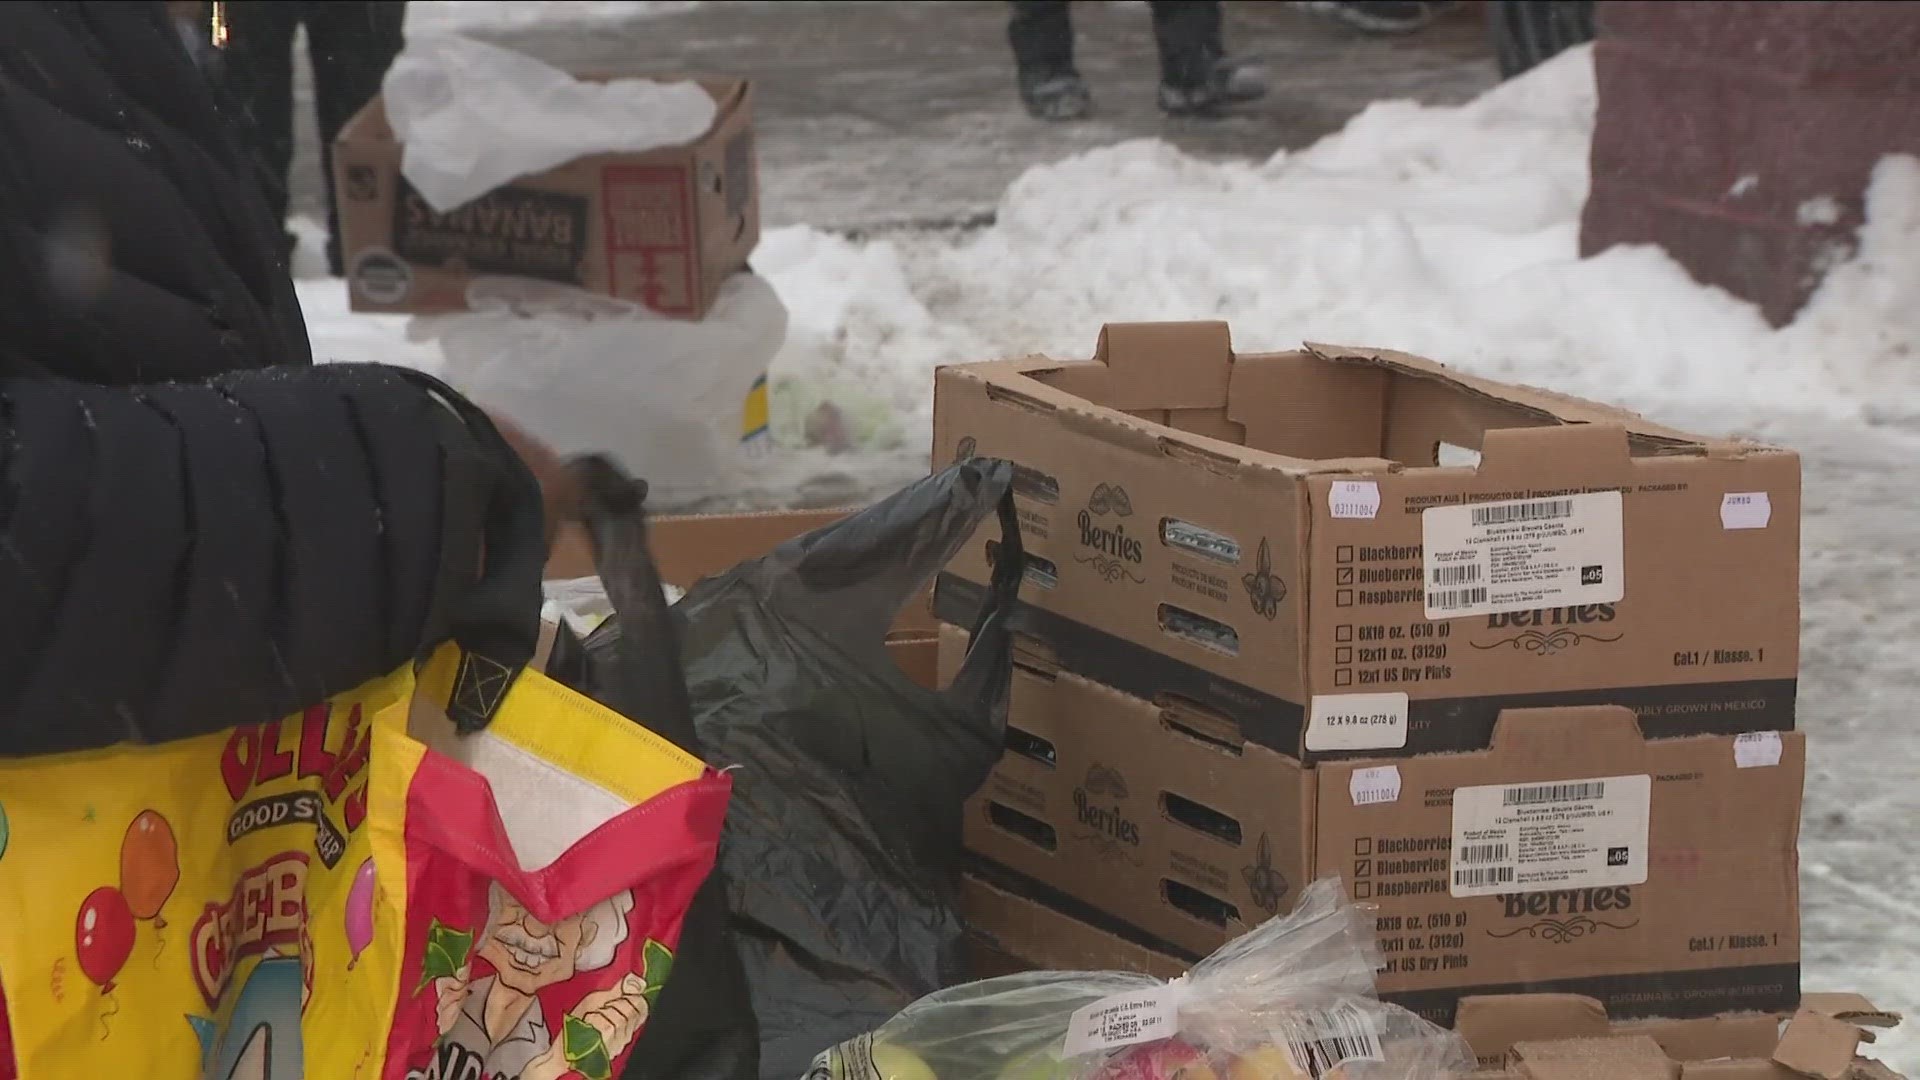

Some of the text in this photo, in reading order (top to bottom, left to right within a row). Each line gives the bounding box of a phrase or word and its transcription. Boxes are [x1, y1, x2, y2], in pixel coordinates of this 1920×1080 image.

[1405, 495, 1443, 504] PRODUKT
[1444, 495, 1459, 503] AUS
[1469, 492, 1512, 501] PRODUCTO
[1513, 491, 1524, 500] DE
[1638, 484, 1677, 493] PACKAGED
[1078, 509, 1142, 564] Berries
[1359, 567, 1424, 584] Blueberrie
[1359, 589, 1424, 606] Raspberrie
[1389, 626, 1405, 639] oz.
[1410, 624, 1433, 640] (510
[1438, 622, 1450, 637] g)
[1391, 647, 1407, 661] oz.
[1412, 644, 1447, 661] (312g)
[1673, 648, 1764, 667] Cat.1 / Klasse. 1
[1384, 668, 1398, 682] US
[1402, 667, 1421, 683] Dry
[1425, 665, 1451, 680] Pints
[1665, 703, 1708, 714] GROWN
[1710, 702, 1722, 712] IN
[1724, 699, 1766, 711] MEXICO
[1326, 715, 1335, 726] 12
[1345, 715, 1358, 725] 9.8
[1359, 716, 1369, 724] oz
[230, 801, 288, 838] GOOD
[1073, 787, 1140, 847] Berries
[1377, 858, 1447, 876] Blueberries
[1377, 878, 1447, 899] Raspberries
[1406, 916, 1423, 930] oz.
[1455, 910, 1467, 929] g)
[1380, 932, 1464, 953] 2x11 oz. (312g)
[1718, 936, 1725, 950] /
[1773, 933, 1778, 947] 1
[1402, 958, 1415, 972] US
[1420, 957, 1439, 974] Dry
[1443, 954, 1469, 969] Pints
